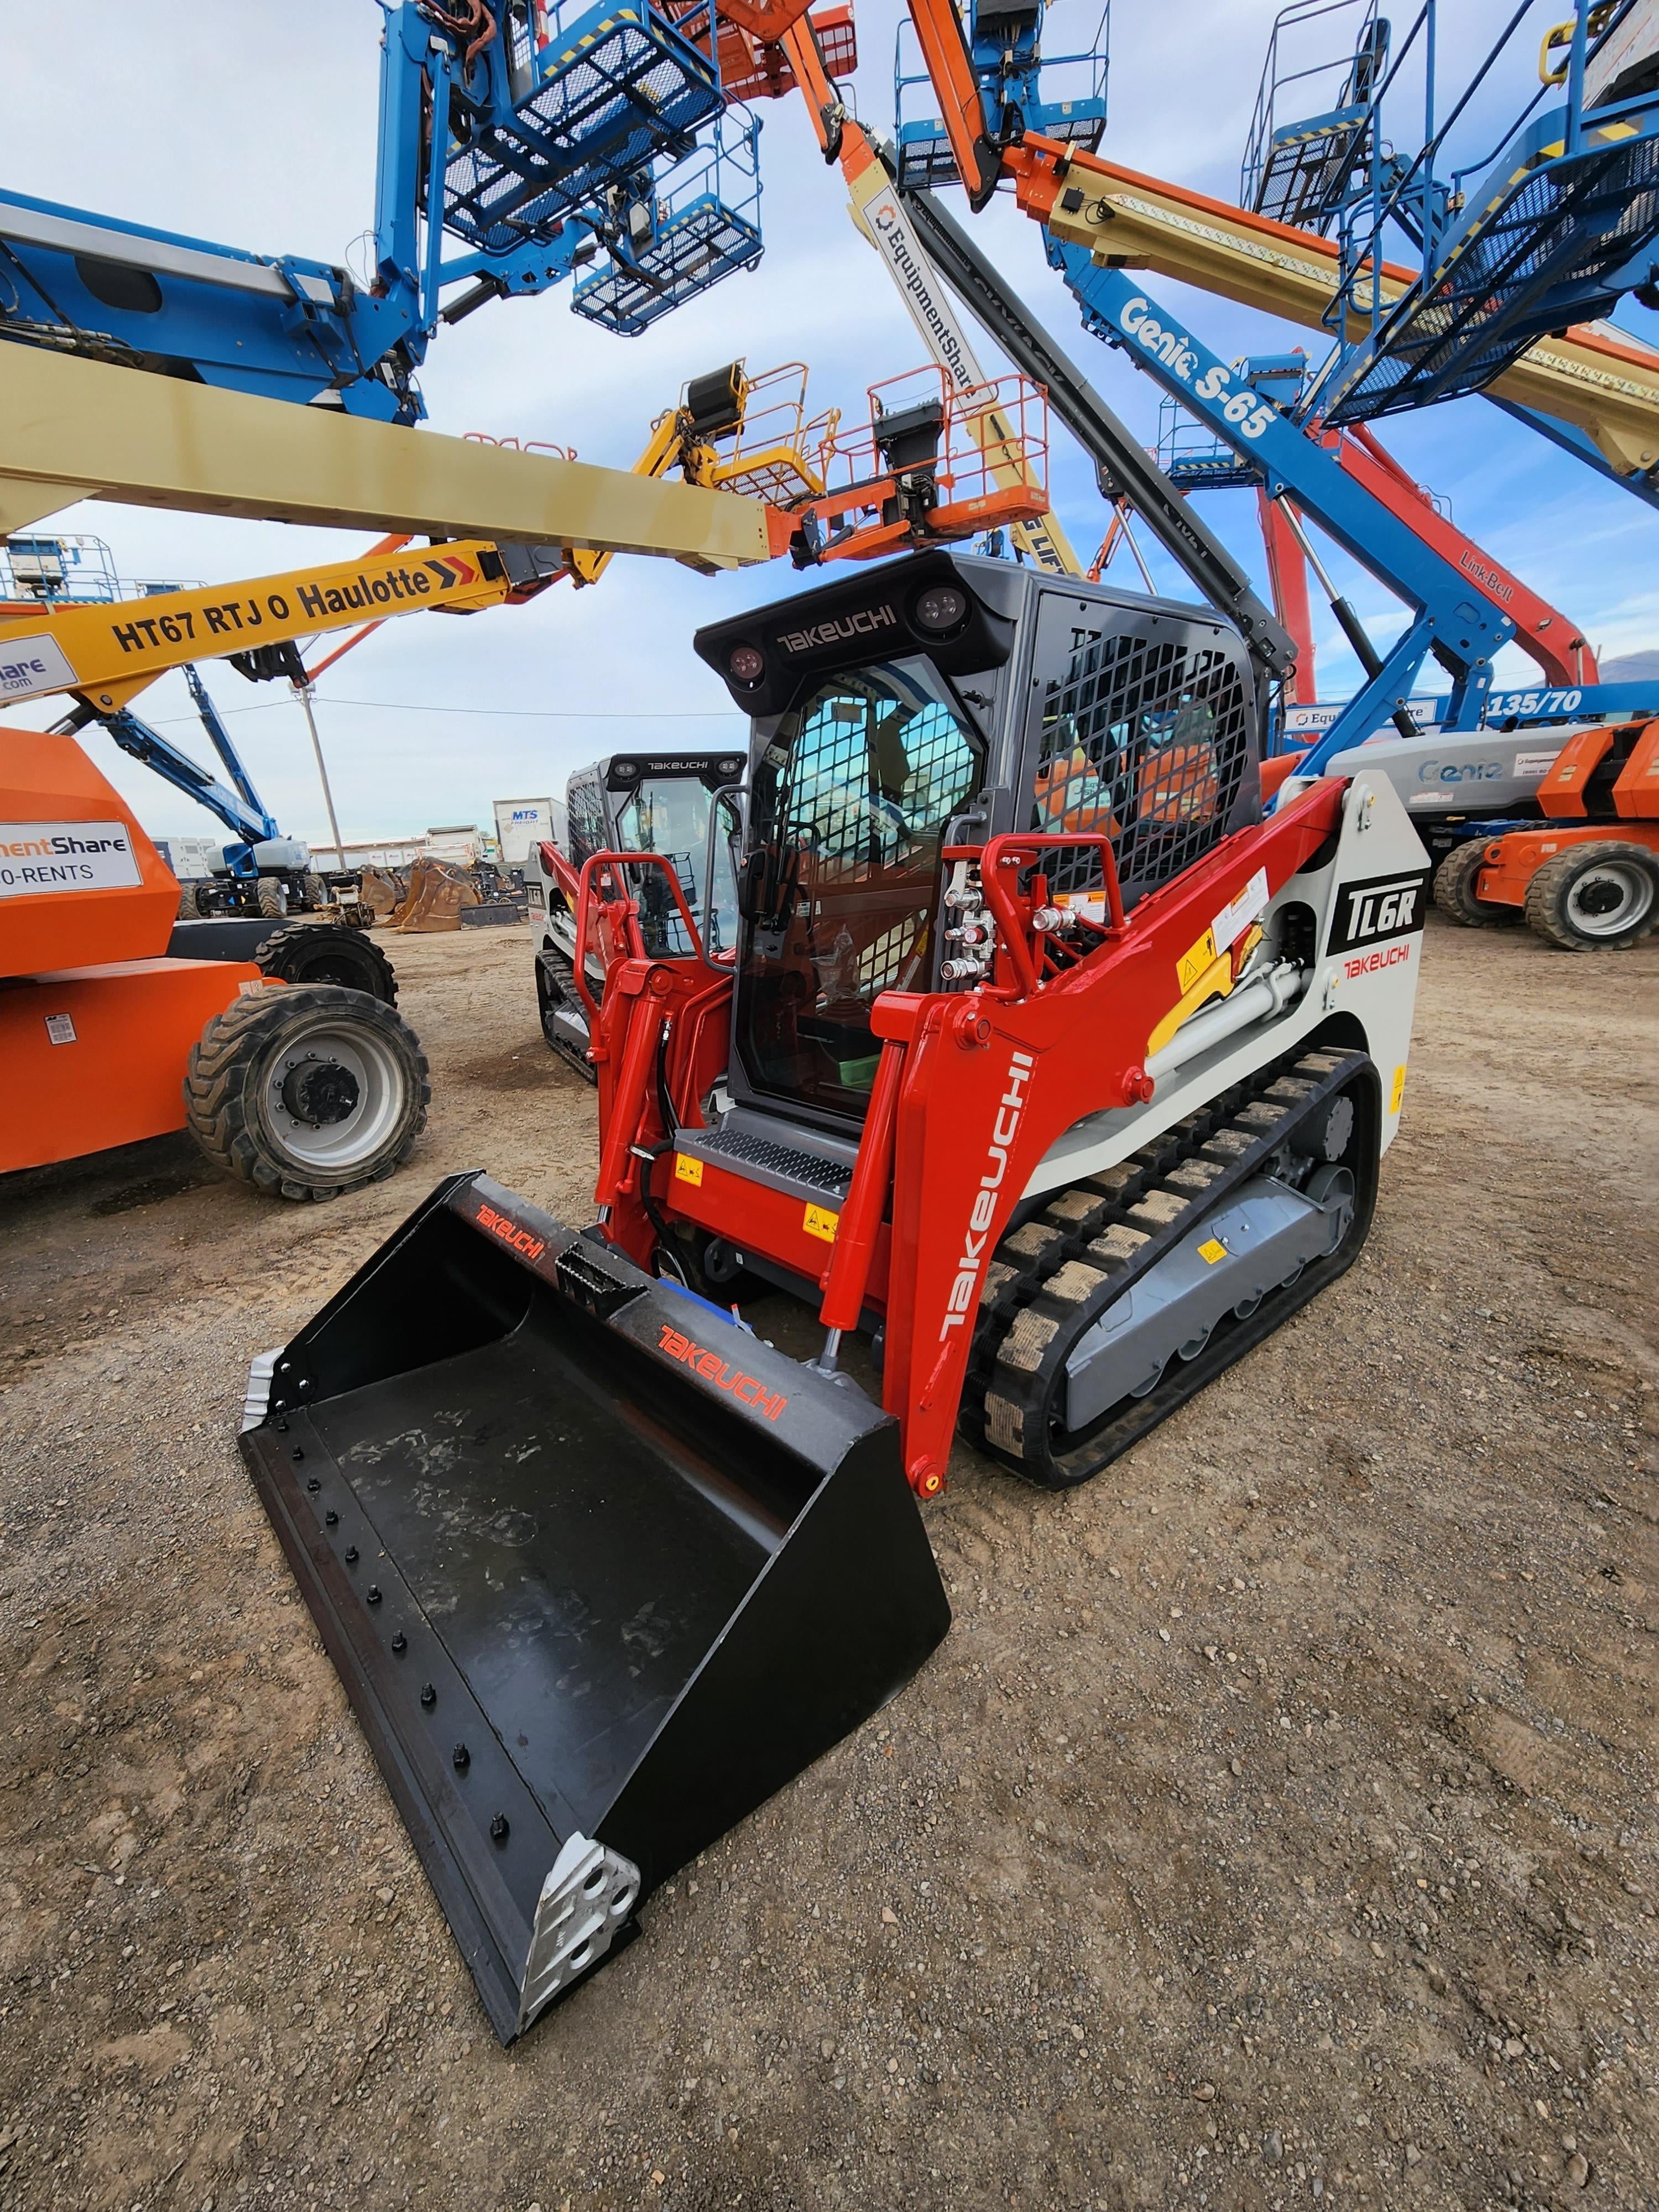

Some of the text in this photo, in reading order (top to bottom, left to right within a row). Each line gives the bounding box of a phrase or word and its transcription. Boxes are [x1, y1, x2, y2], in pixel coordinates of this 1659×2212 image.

[886, 226, 976, 399] EquipmentShare
[1120, 297, 1199, 382] Genie
[1194, 366, 1278, 439] S-65
[112, 612, 196, 653] HT67
[204, 599, 263, 634] RTJ
[296, 568, 430, 618] Haulotte
[776, 604, 898, 653] TAKEUCHI
[647, 761, 708, 770] TAKEUCHI
[1418, 759, 1504, 784] Genie
[512, 810, 539, 820] MTS
[0, 864, 94, 885] 0-RENTS
[1346, 878, 1424, 941] TL6R
[1344, 944, 1410, 979] TAKEUCHI
[939, 1051, 1033, 1342] TAKEUCHI
[476, 1204, 544, 1259] TAKEUCHI
[657, 1325, 788, 1421] TAKEUCHI
